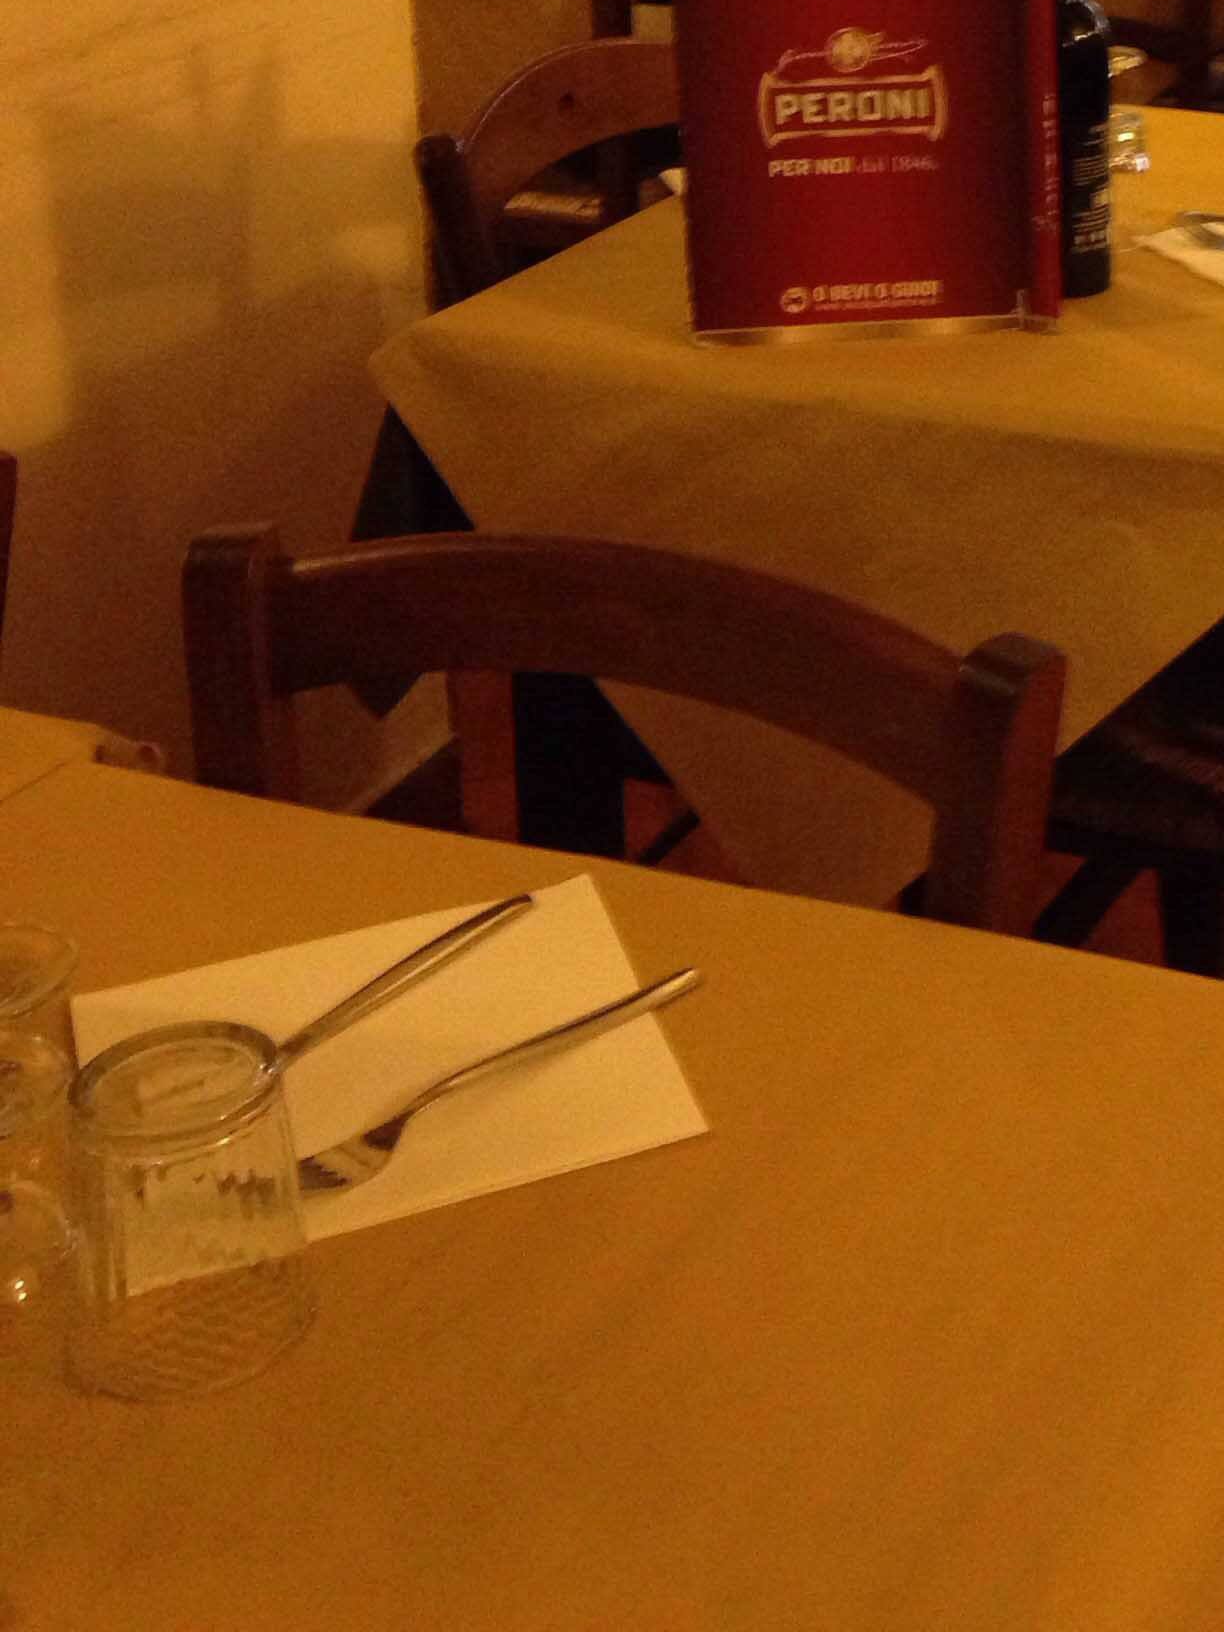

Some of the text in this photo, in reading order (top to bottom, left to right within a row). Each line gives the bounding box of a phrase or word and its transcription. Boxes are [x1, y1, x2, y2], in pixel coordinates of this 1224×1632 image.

[775, 87, 930, 125] PERONI
[768, 159, 809, 177] PER
[815, 156, 851, 175] NOI
